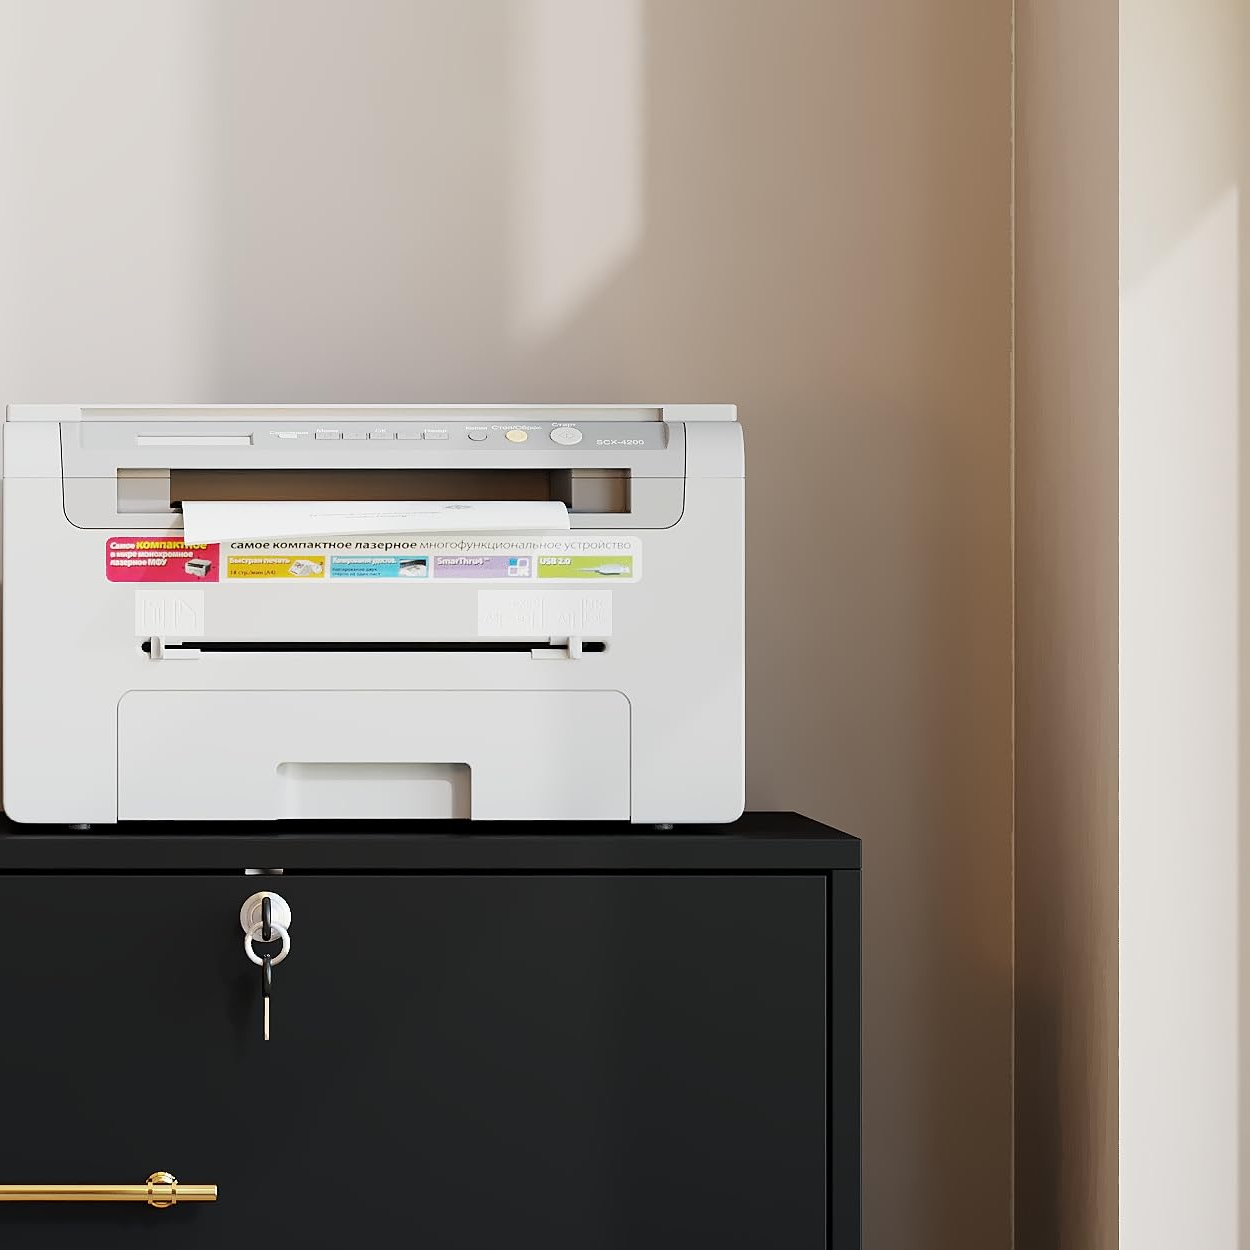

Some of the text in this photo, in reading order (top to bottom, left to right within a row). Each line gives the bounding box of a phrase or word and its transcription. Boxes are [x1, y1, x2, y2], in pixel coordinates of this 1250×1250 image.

[230, 539, 632, 551] самое компактное лазерное многофункциональное устройство
[539, 557, 557, 565] USB
